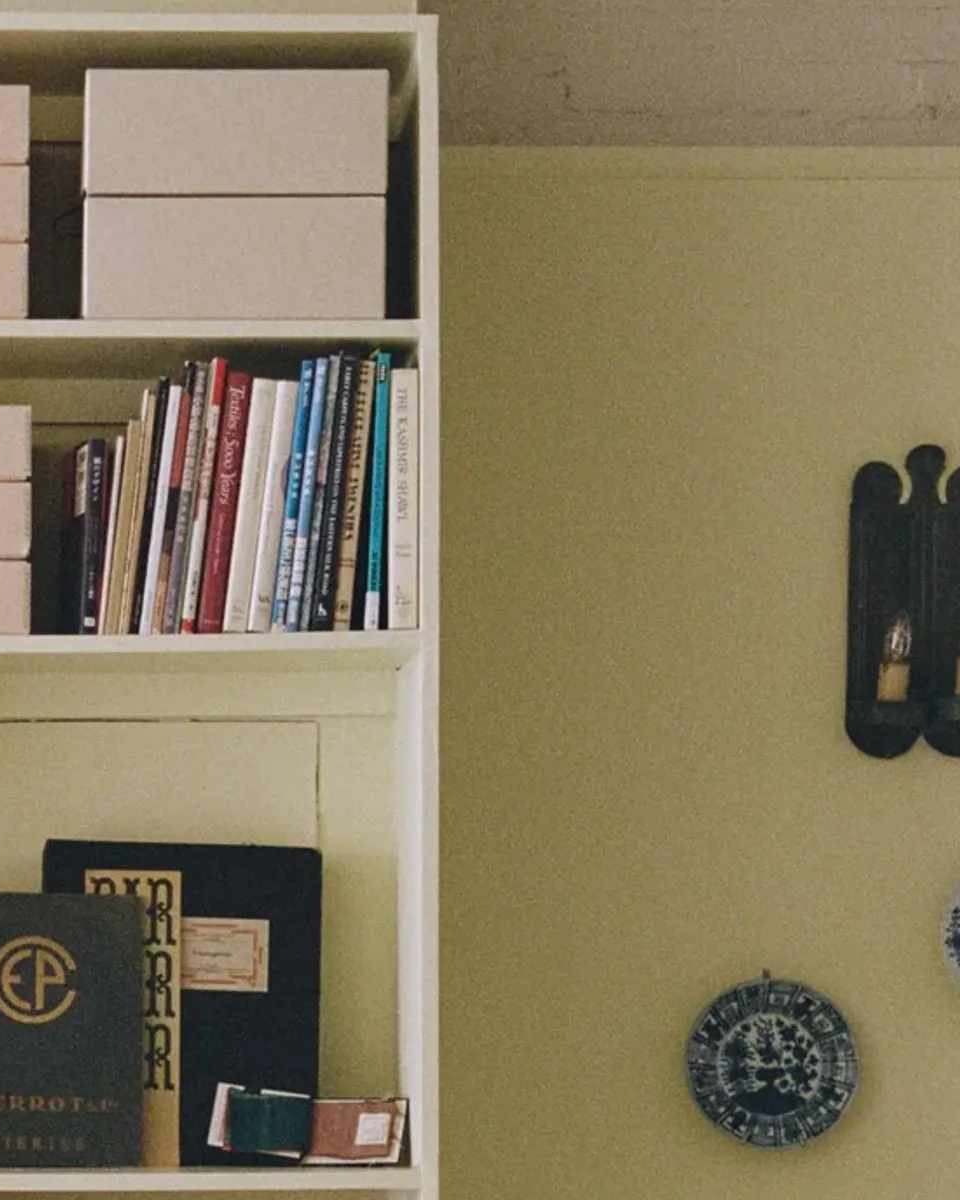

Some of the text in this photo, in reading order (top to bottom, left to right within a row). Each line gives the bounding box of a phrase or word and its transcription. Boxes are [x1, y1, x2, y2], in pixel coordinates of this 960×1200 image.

[215, 469, 236, 505] Years
[395, 387, 408, 523] THE KASHMIR SHAWL
